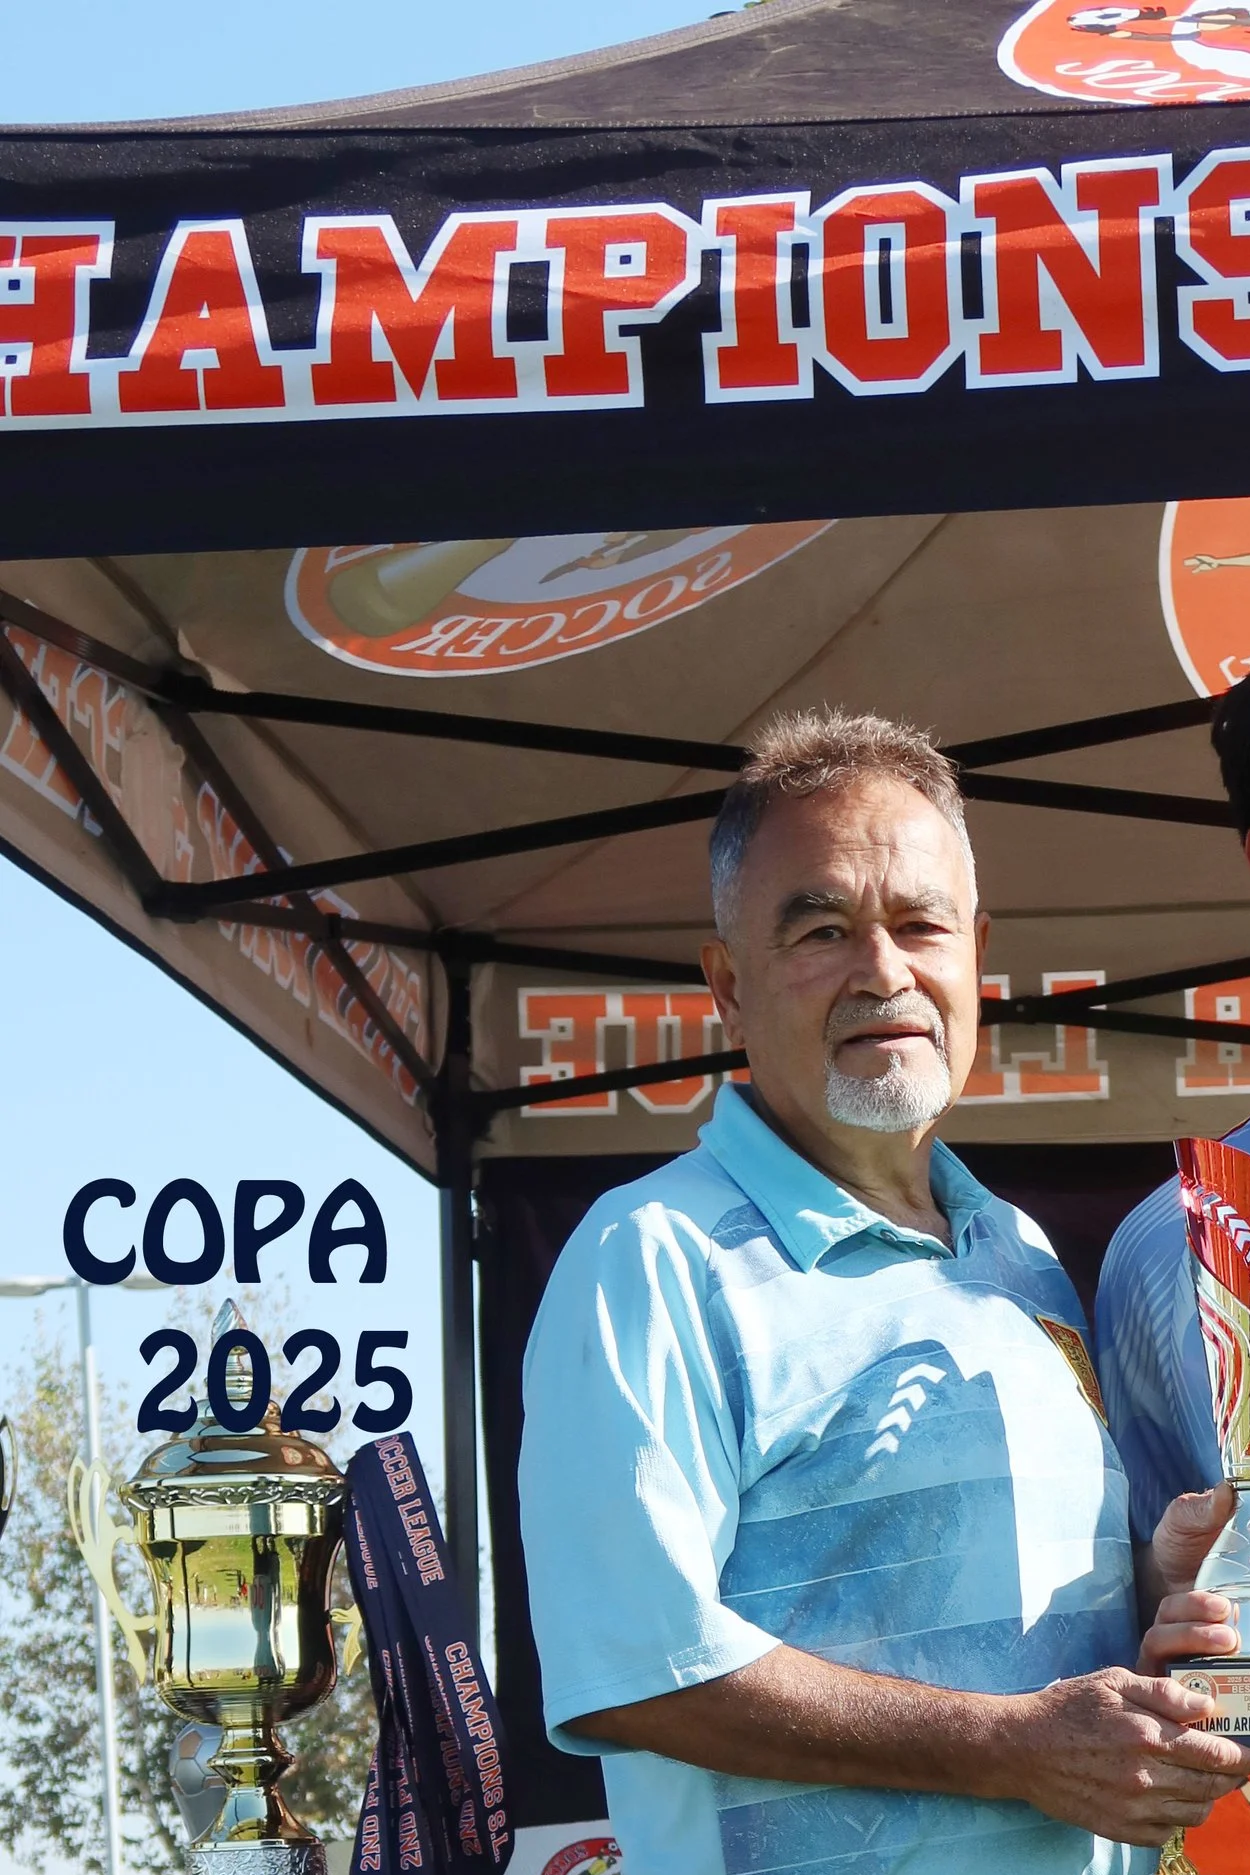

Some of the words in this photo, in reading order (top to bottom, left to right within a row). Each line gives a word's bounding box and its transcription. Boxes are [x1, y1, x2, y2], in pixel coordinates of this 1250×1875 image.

[398, 1497, 446, 1587] LEAGUE
[444, 1640, 505, 1809] CHAMPIONS
[1184, 1716, 1231, 1732] MILIANO
[359, 1814, 382, 1872] 2ND
[399, 1811, 423, 1871] 2ND
